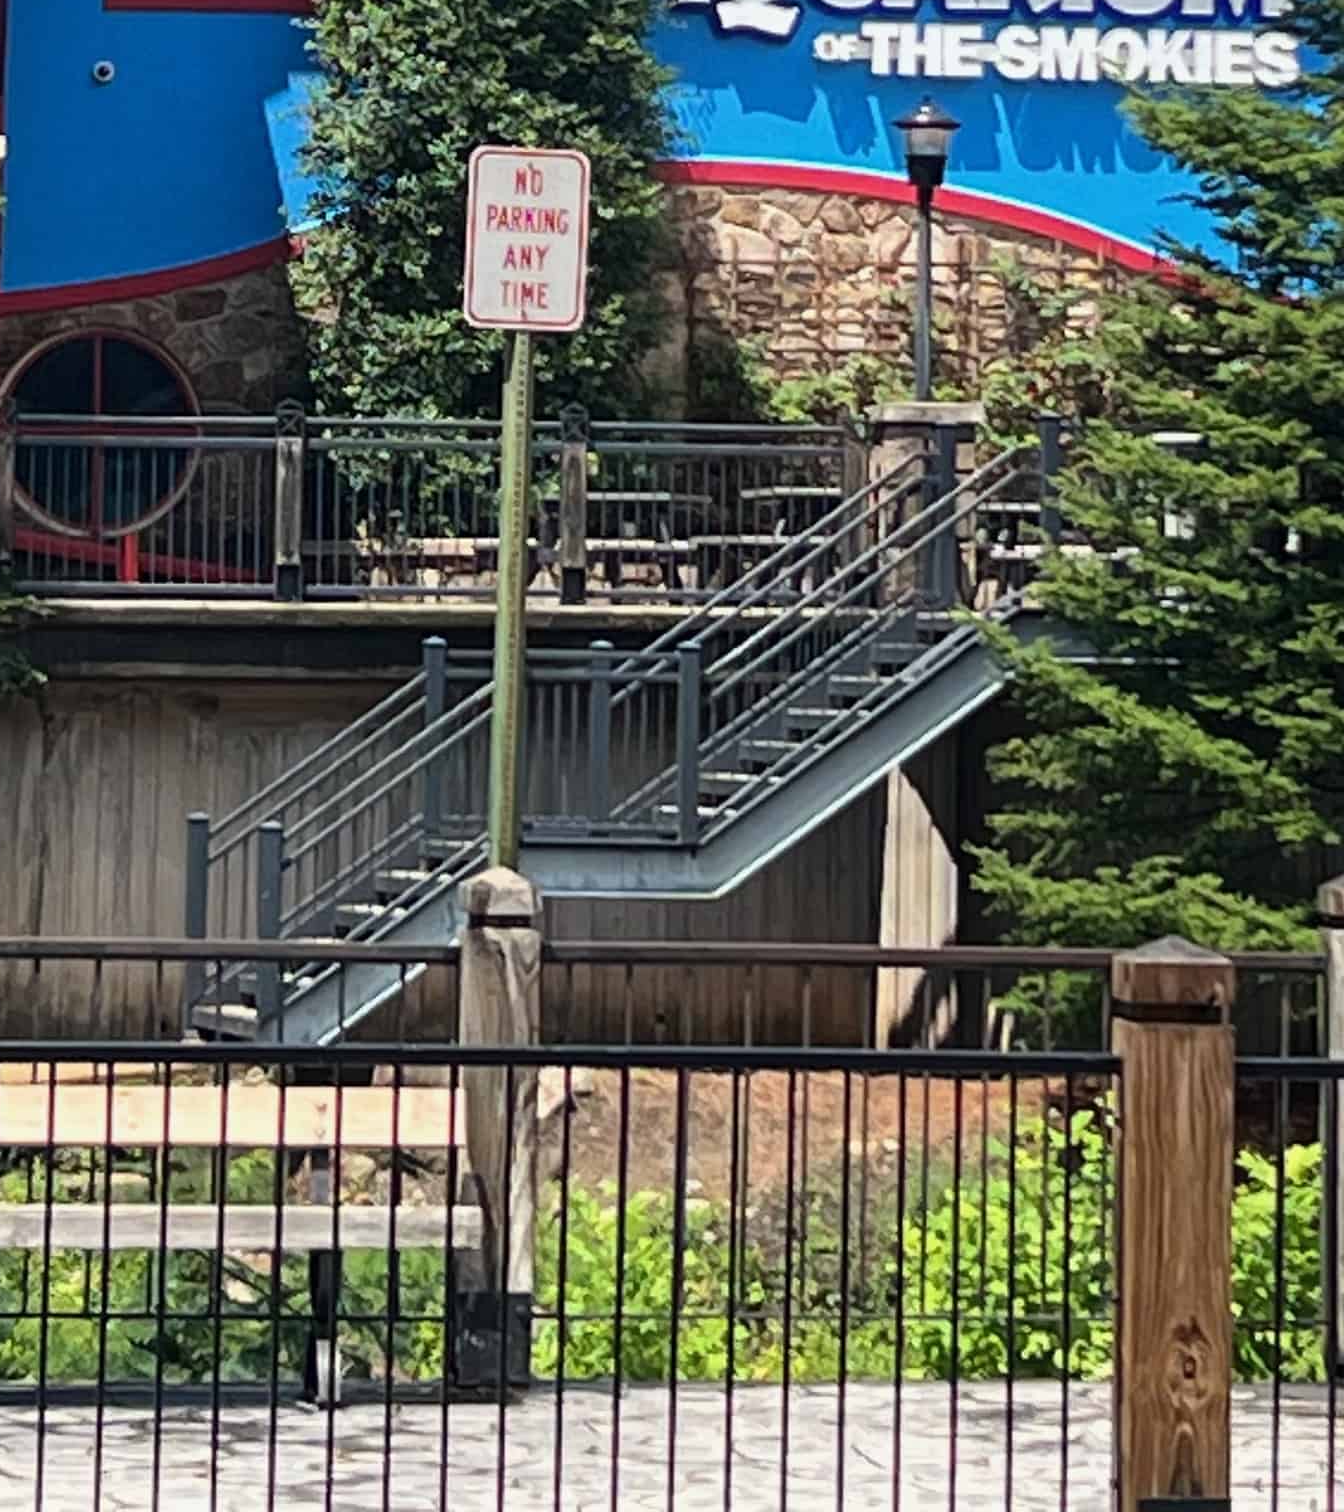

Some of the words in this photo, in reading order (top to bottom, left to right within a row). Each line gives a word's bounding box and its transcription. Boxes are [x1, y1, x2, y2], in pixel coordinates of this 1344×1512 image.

[860, 23, 984, 76] THE
[994, 24, 1301, 87] SMOKIES
[514, 167, 544, 197] NO
[486, 203, 570, 235] PARKING
[503, 244, 550, 271] ANY
[500, 280, 549, 309] TIME
